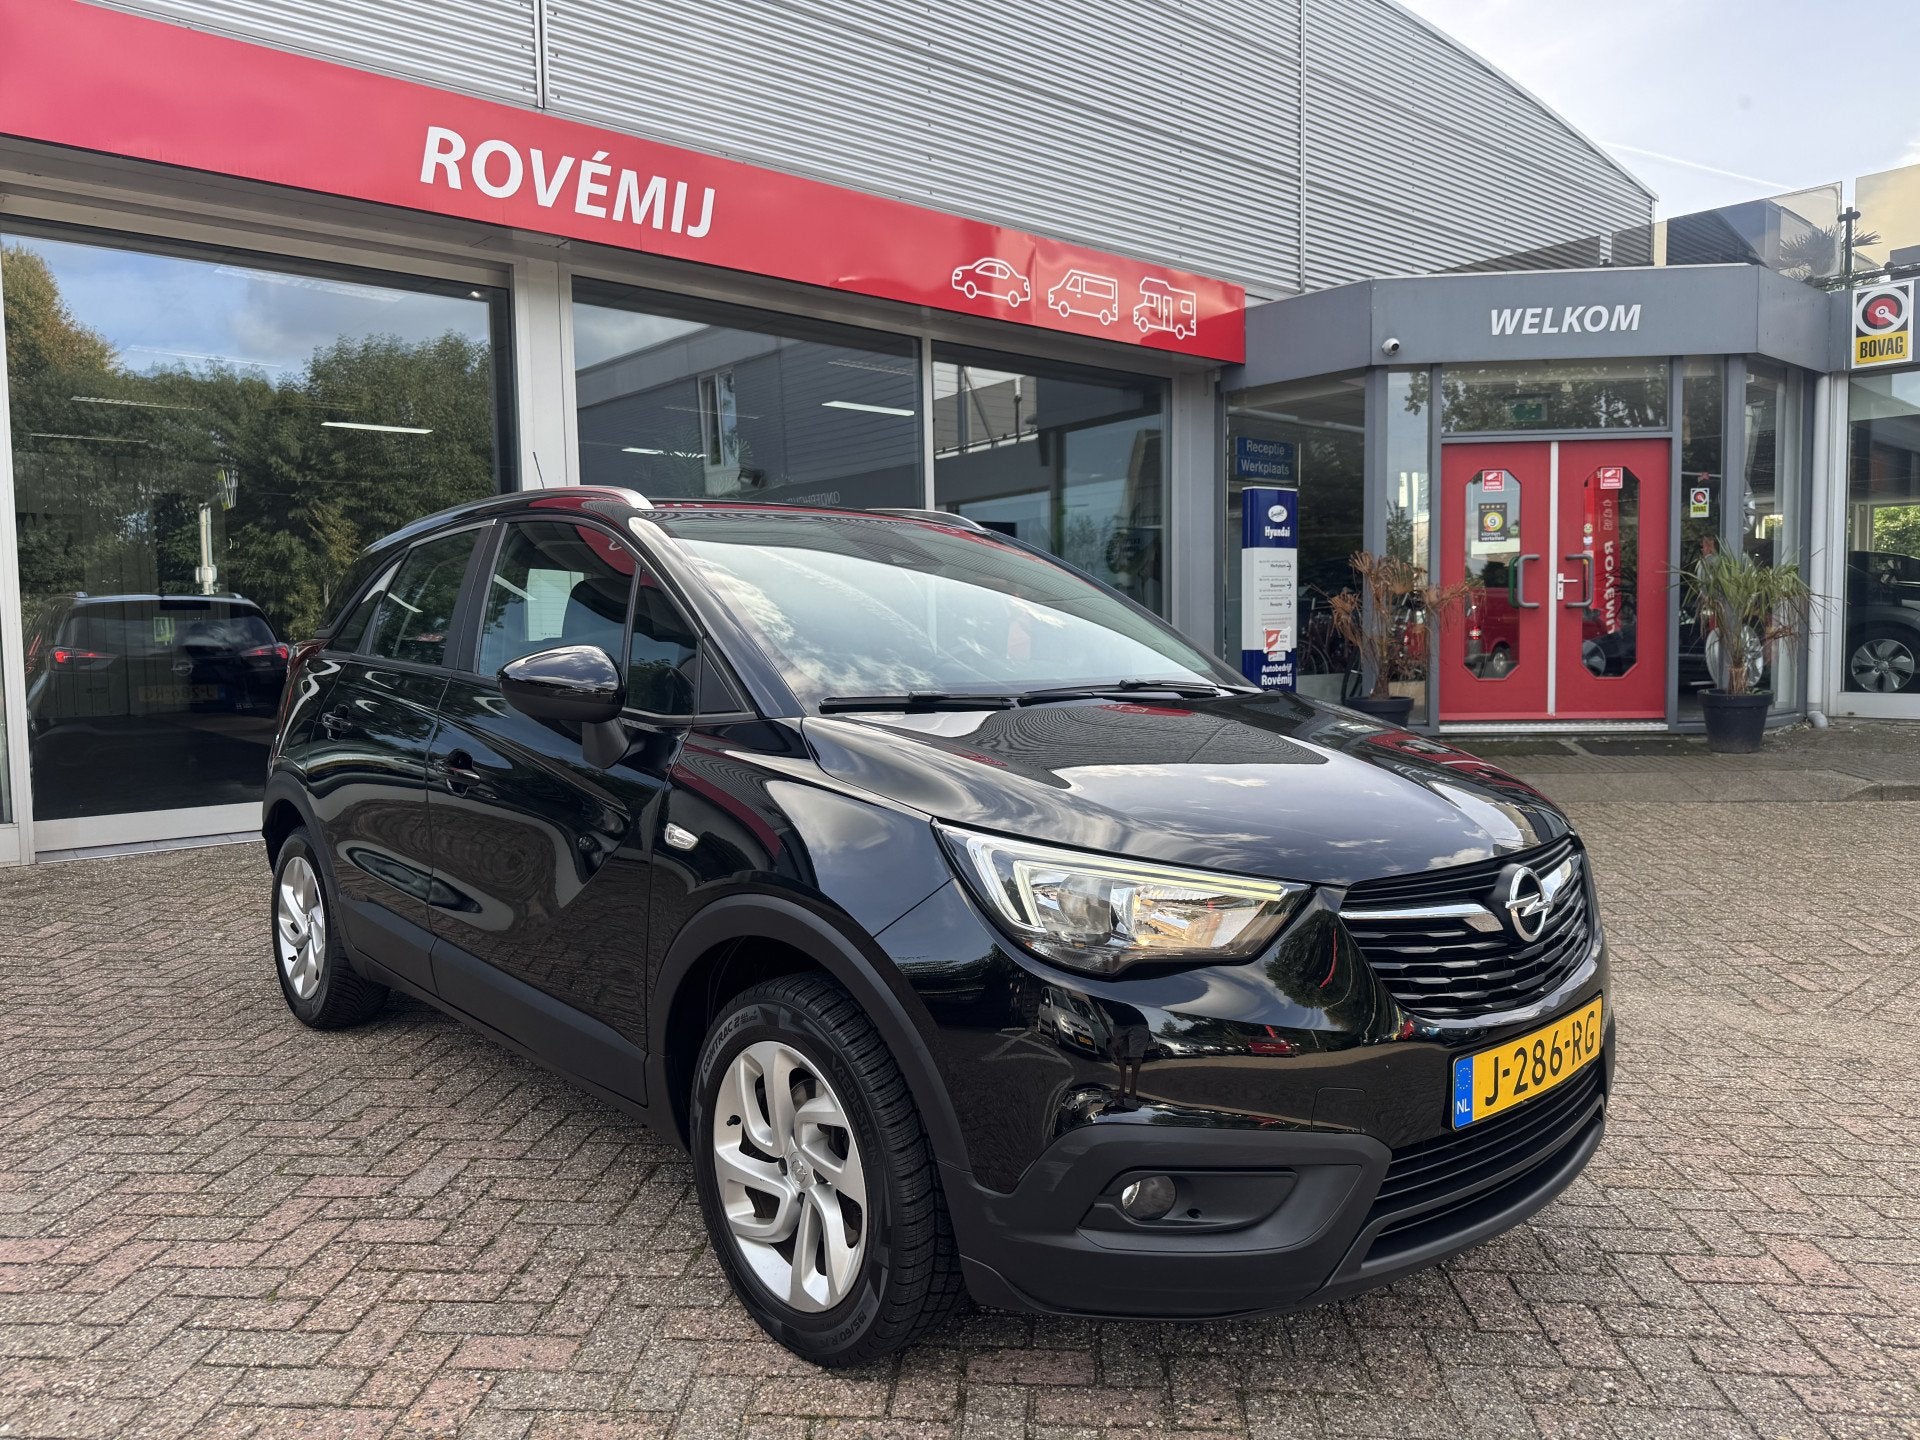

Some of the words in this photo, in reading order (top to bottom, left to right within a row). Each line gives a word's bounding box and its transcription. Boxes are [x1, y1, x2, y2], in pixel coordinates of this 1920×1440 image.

[420, 126, 715, 238] ROVÉMIJ
[1490, 304, 1641, 336] WELKOM
[1860, 336, 1903, 359] BOVAG
[1246, 440, 1285, 457] Receptie
[1241, 459, 1290, 476] Werkplaats
[1264, 525, 1290, 539] Hyundai
[1262, 663, 1293, 673] Autobedrijf
[1261, 673, 1293, 687] Rovémij
[703, 1020, 733, 1074] COMTRAC
[734, 1016, 741, 1029] 2
[1484, 1011, 1595, 1107] J-286-RG
[831, 1054, 879, 1167] VREDESTEIN
[1456, 1098, 1470, 1115] NL
[839, 1309, 867, 1341] 195/60
